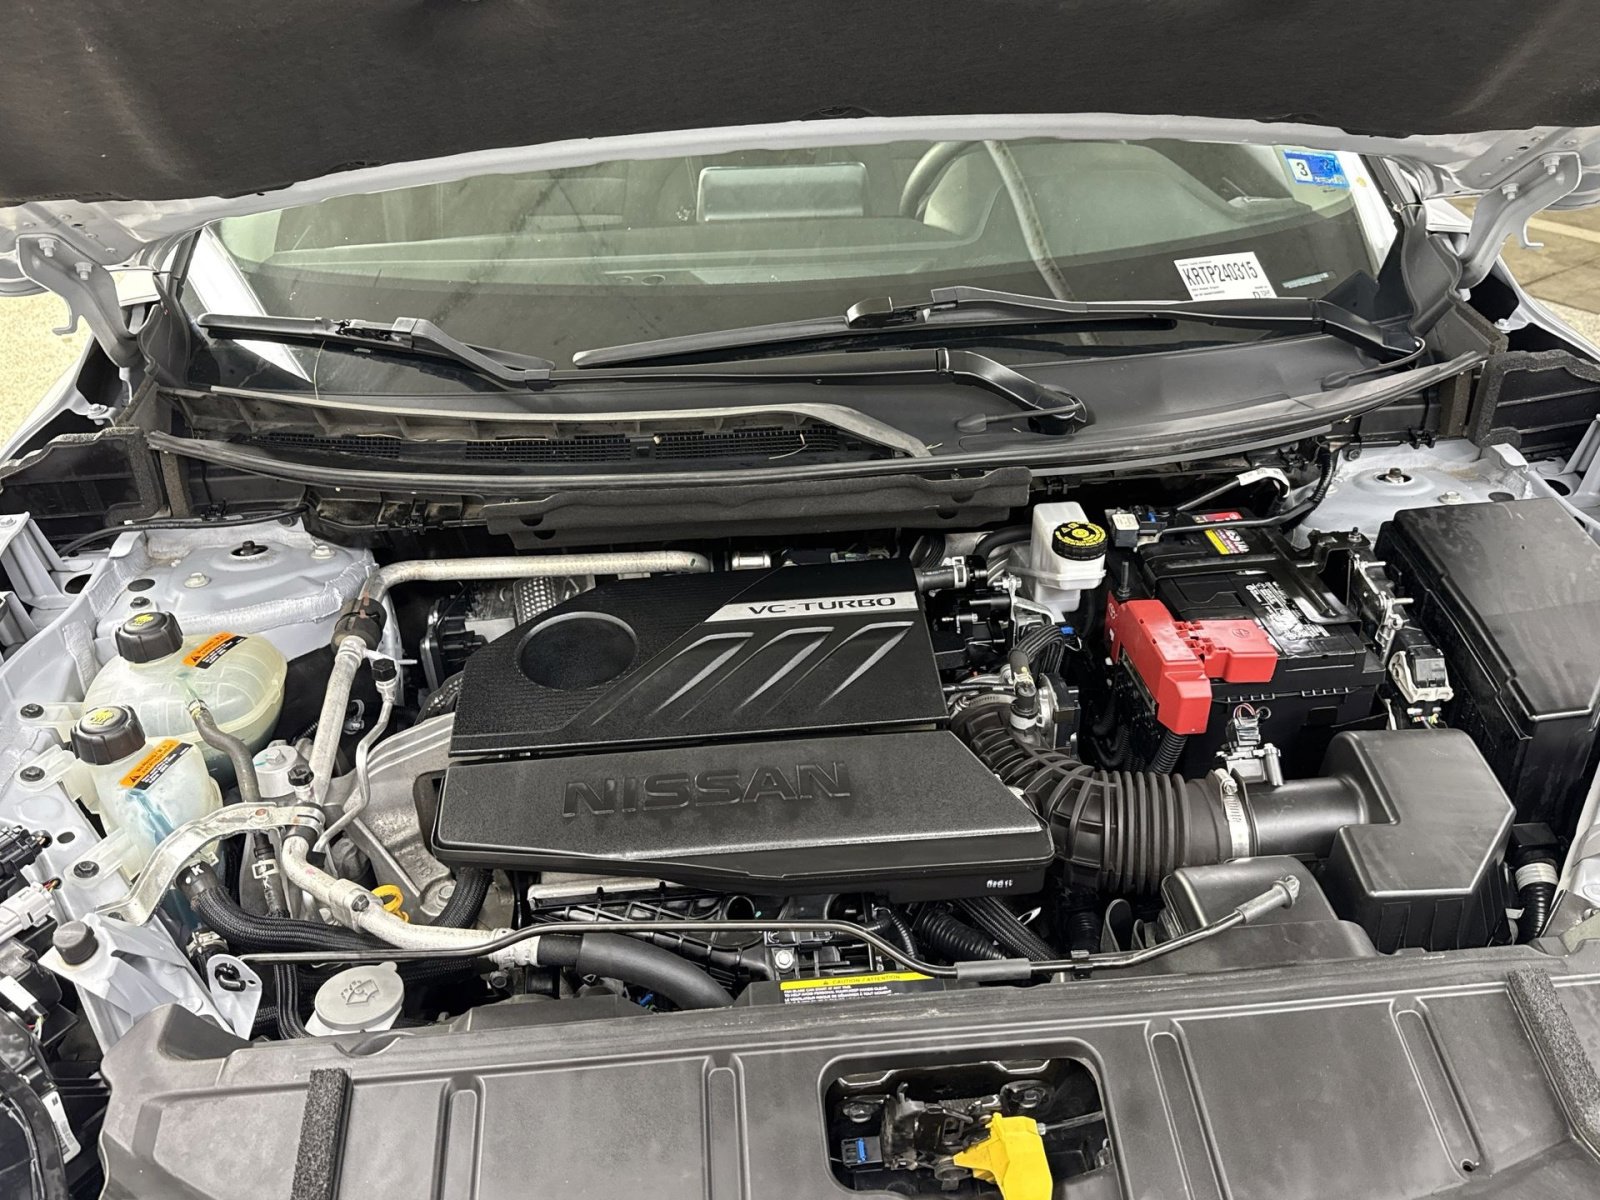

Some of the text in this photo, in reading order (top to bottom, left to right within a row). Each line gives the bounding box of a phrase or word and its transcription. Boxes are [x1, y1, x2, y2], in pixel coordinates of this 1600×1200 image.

[1296, 162, 1308, 176] 3
[1182, 261, 1258, 286] KRTP240315
[748, 597, 896, 615] VC-TURBO
[562, 762, 850, 817] NISSAN
